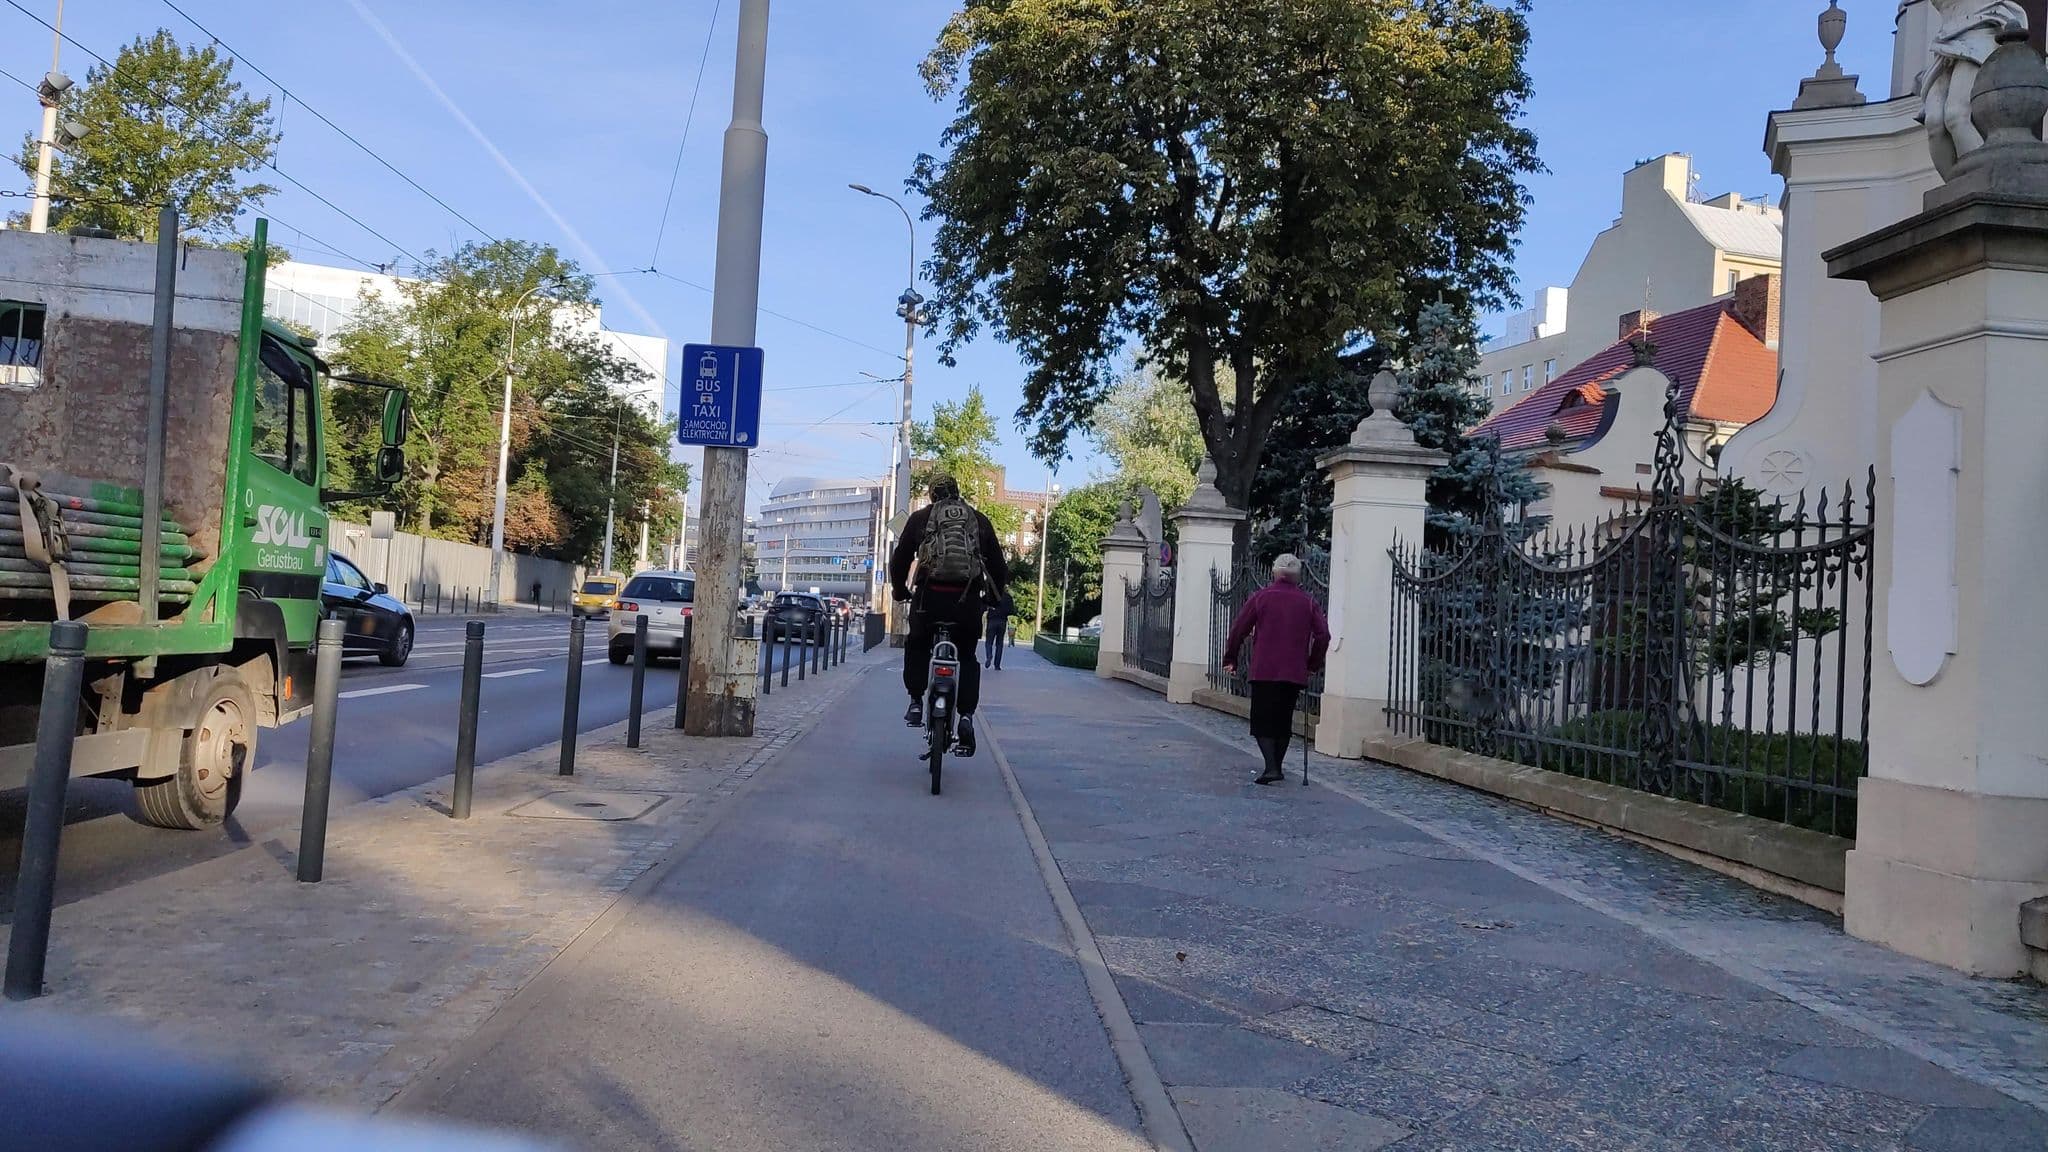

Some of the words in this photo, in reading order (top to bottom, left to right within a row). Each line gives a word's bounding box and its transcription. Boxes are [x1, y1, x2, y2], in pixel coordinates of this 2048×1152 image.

[695, 379, 720, 392] BUS
[692, 404, 721, 417] TAXI
[684, 418, 727, 431] SAMOCHÓD
[682, 429, 729, 440] ELEKTRYCZNY
[257, 548, 304, 570] Gerüstbau
